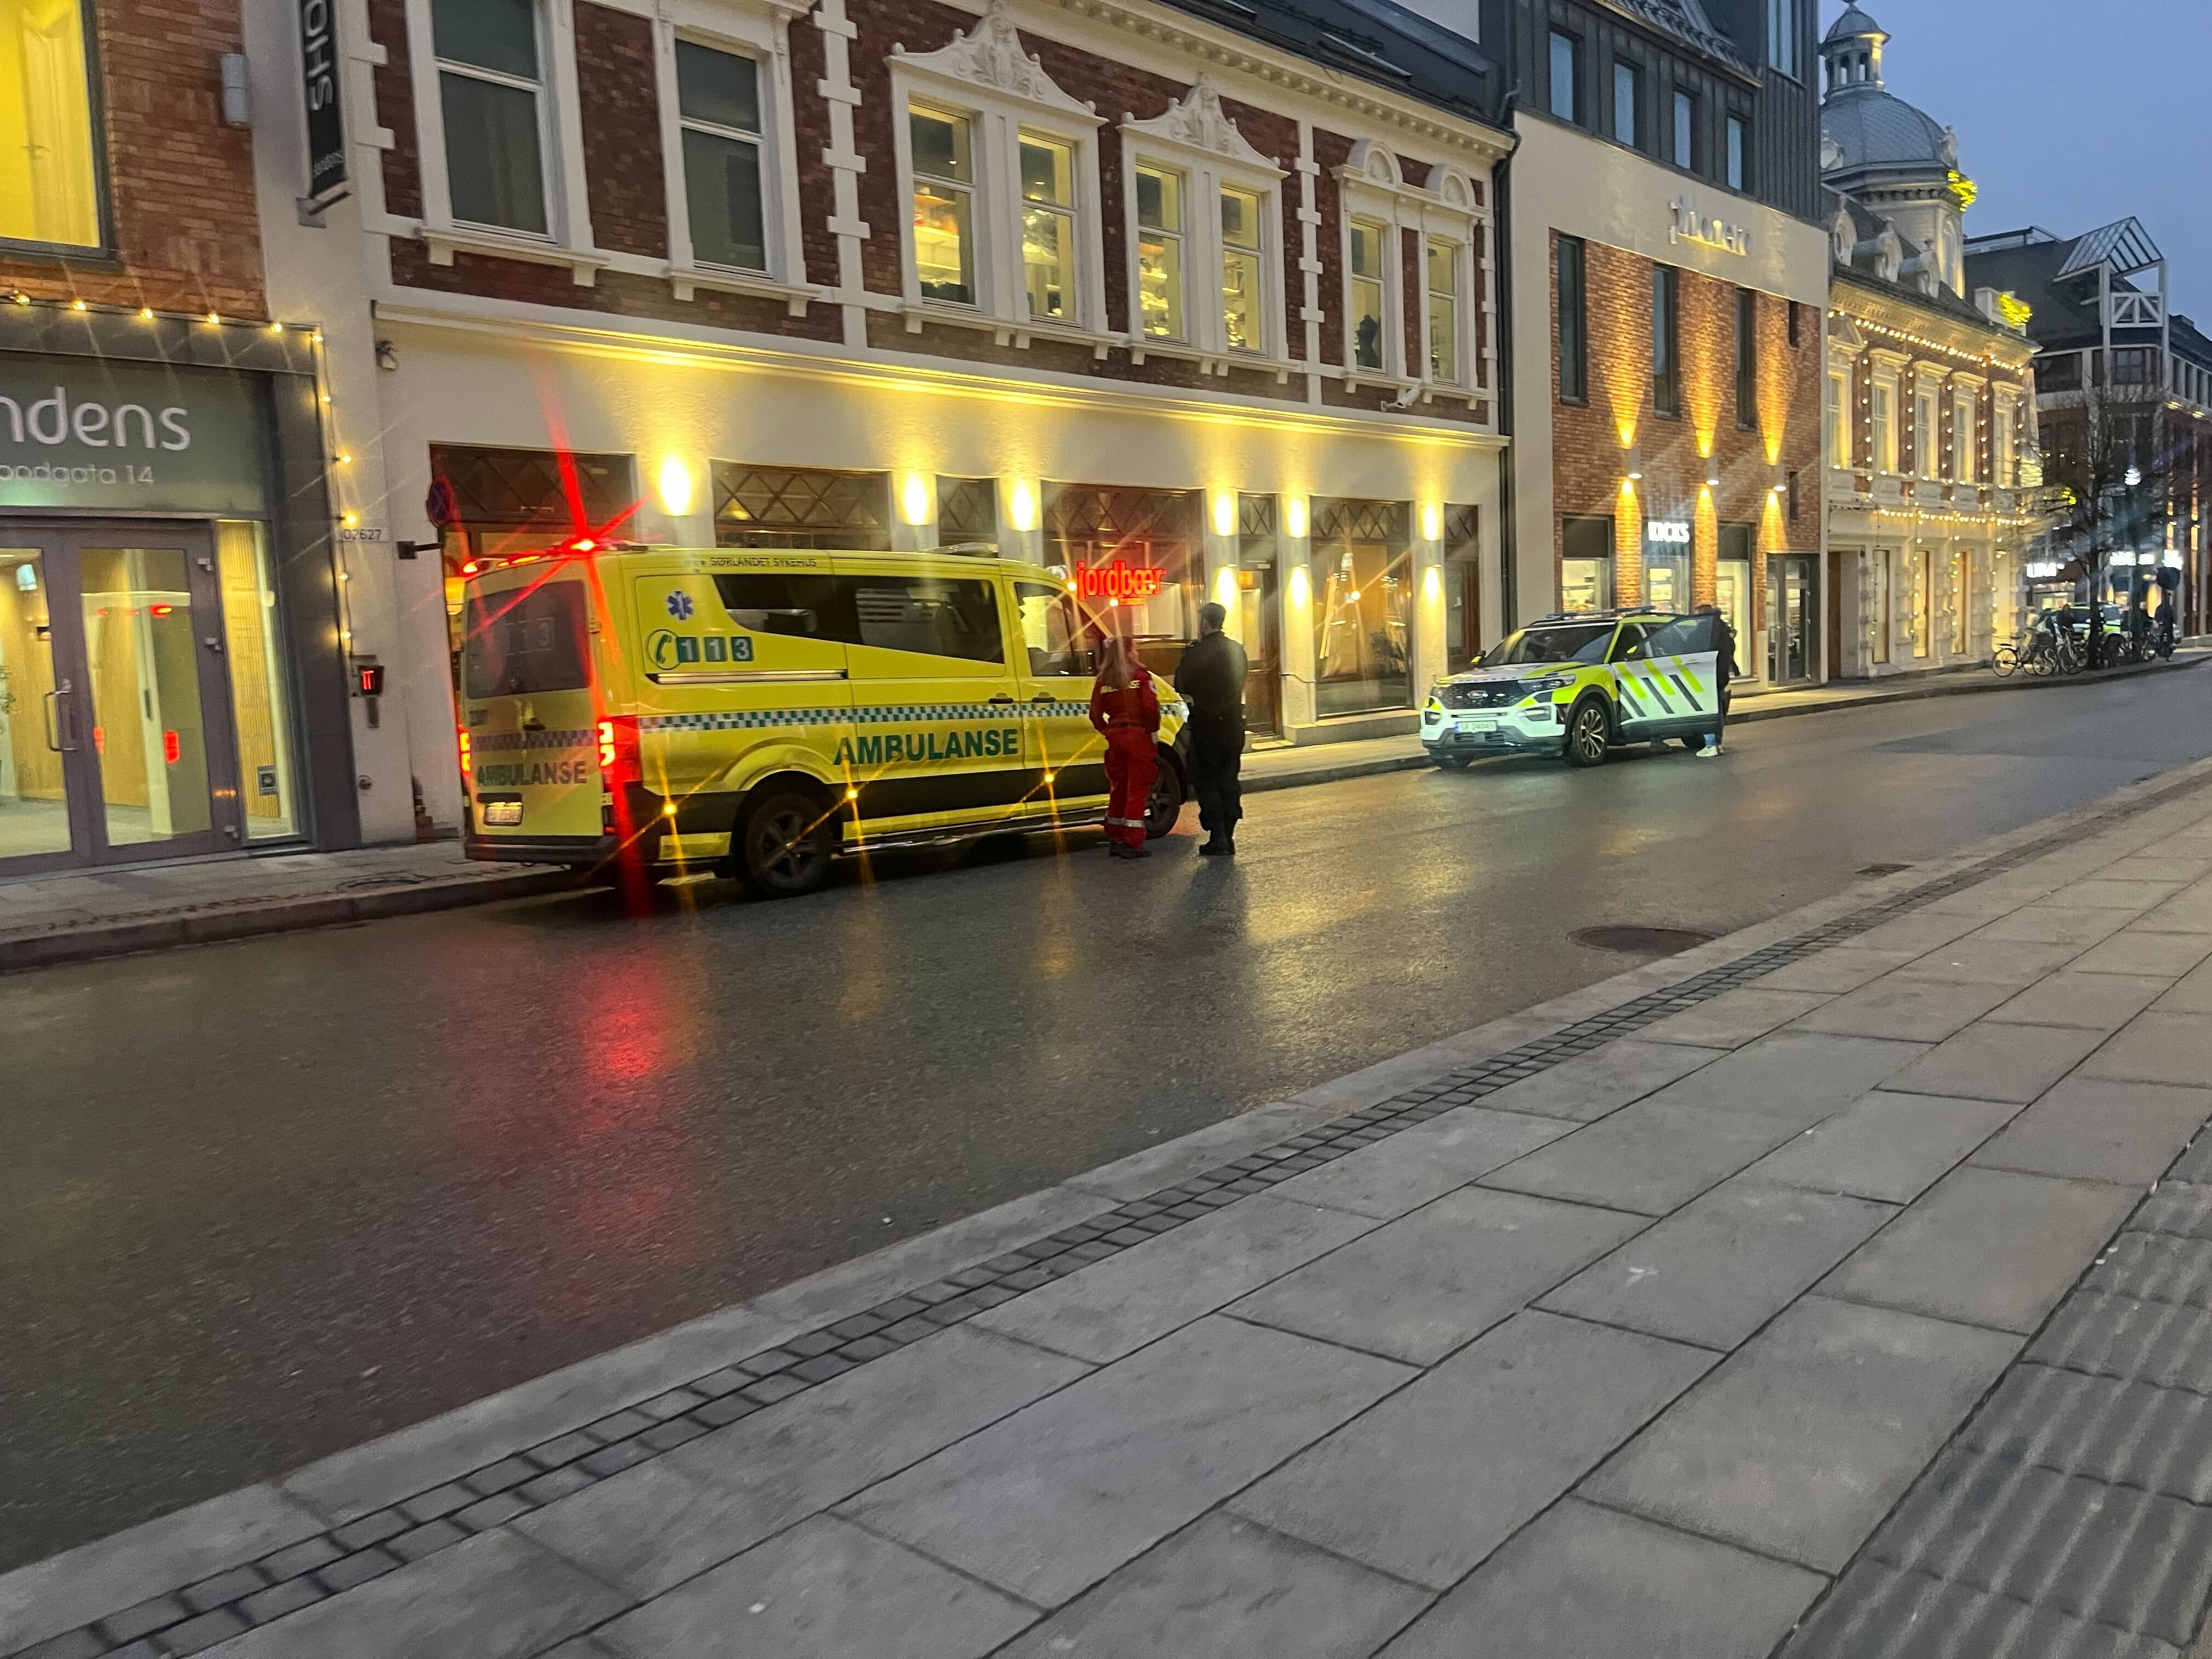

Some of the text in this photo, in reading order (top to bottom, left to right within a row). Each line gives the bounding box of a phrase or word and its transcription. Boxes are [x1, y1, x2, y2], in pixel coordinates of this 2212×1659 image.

[125, 465, 154, 484] 14
[772, 557, 817, 567] SYKEHUS
[1076, 561, 1167, 601] jordbær
[680, 638, 750, 661] 113
[833, 729, 1019, 766] AMBULANSE
[478, 760, 588, 787] AMBULANSE
